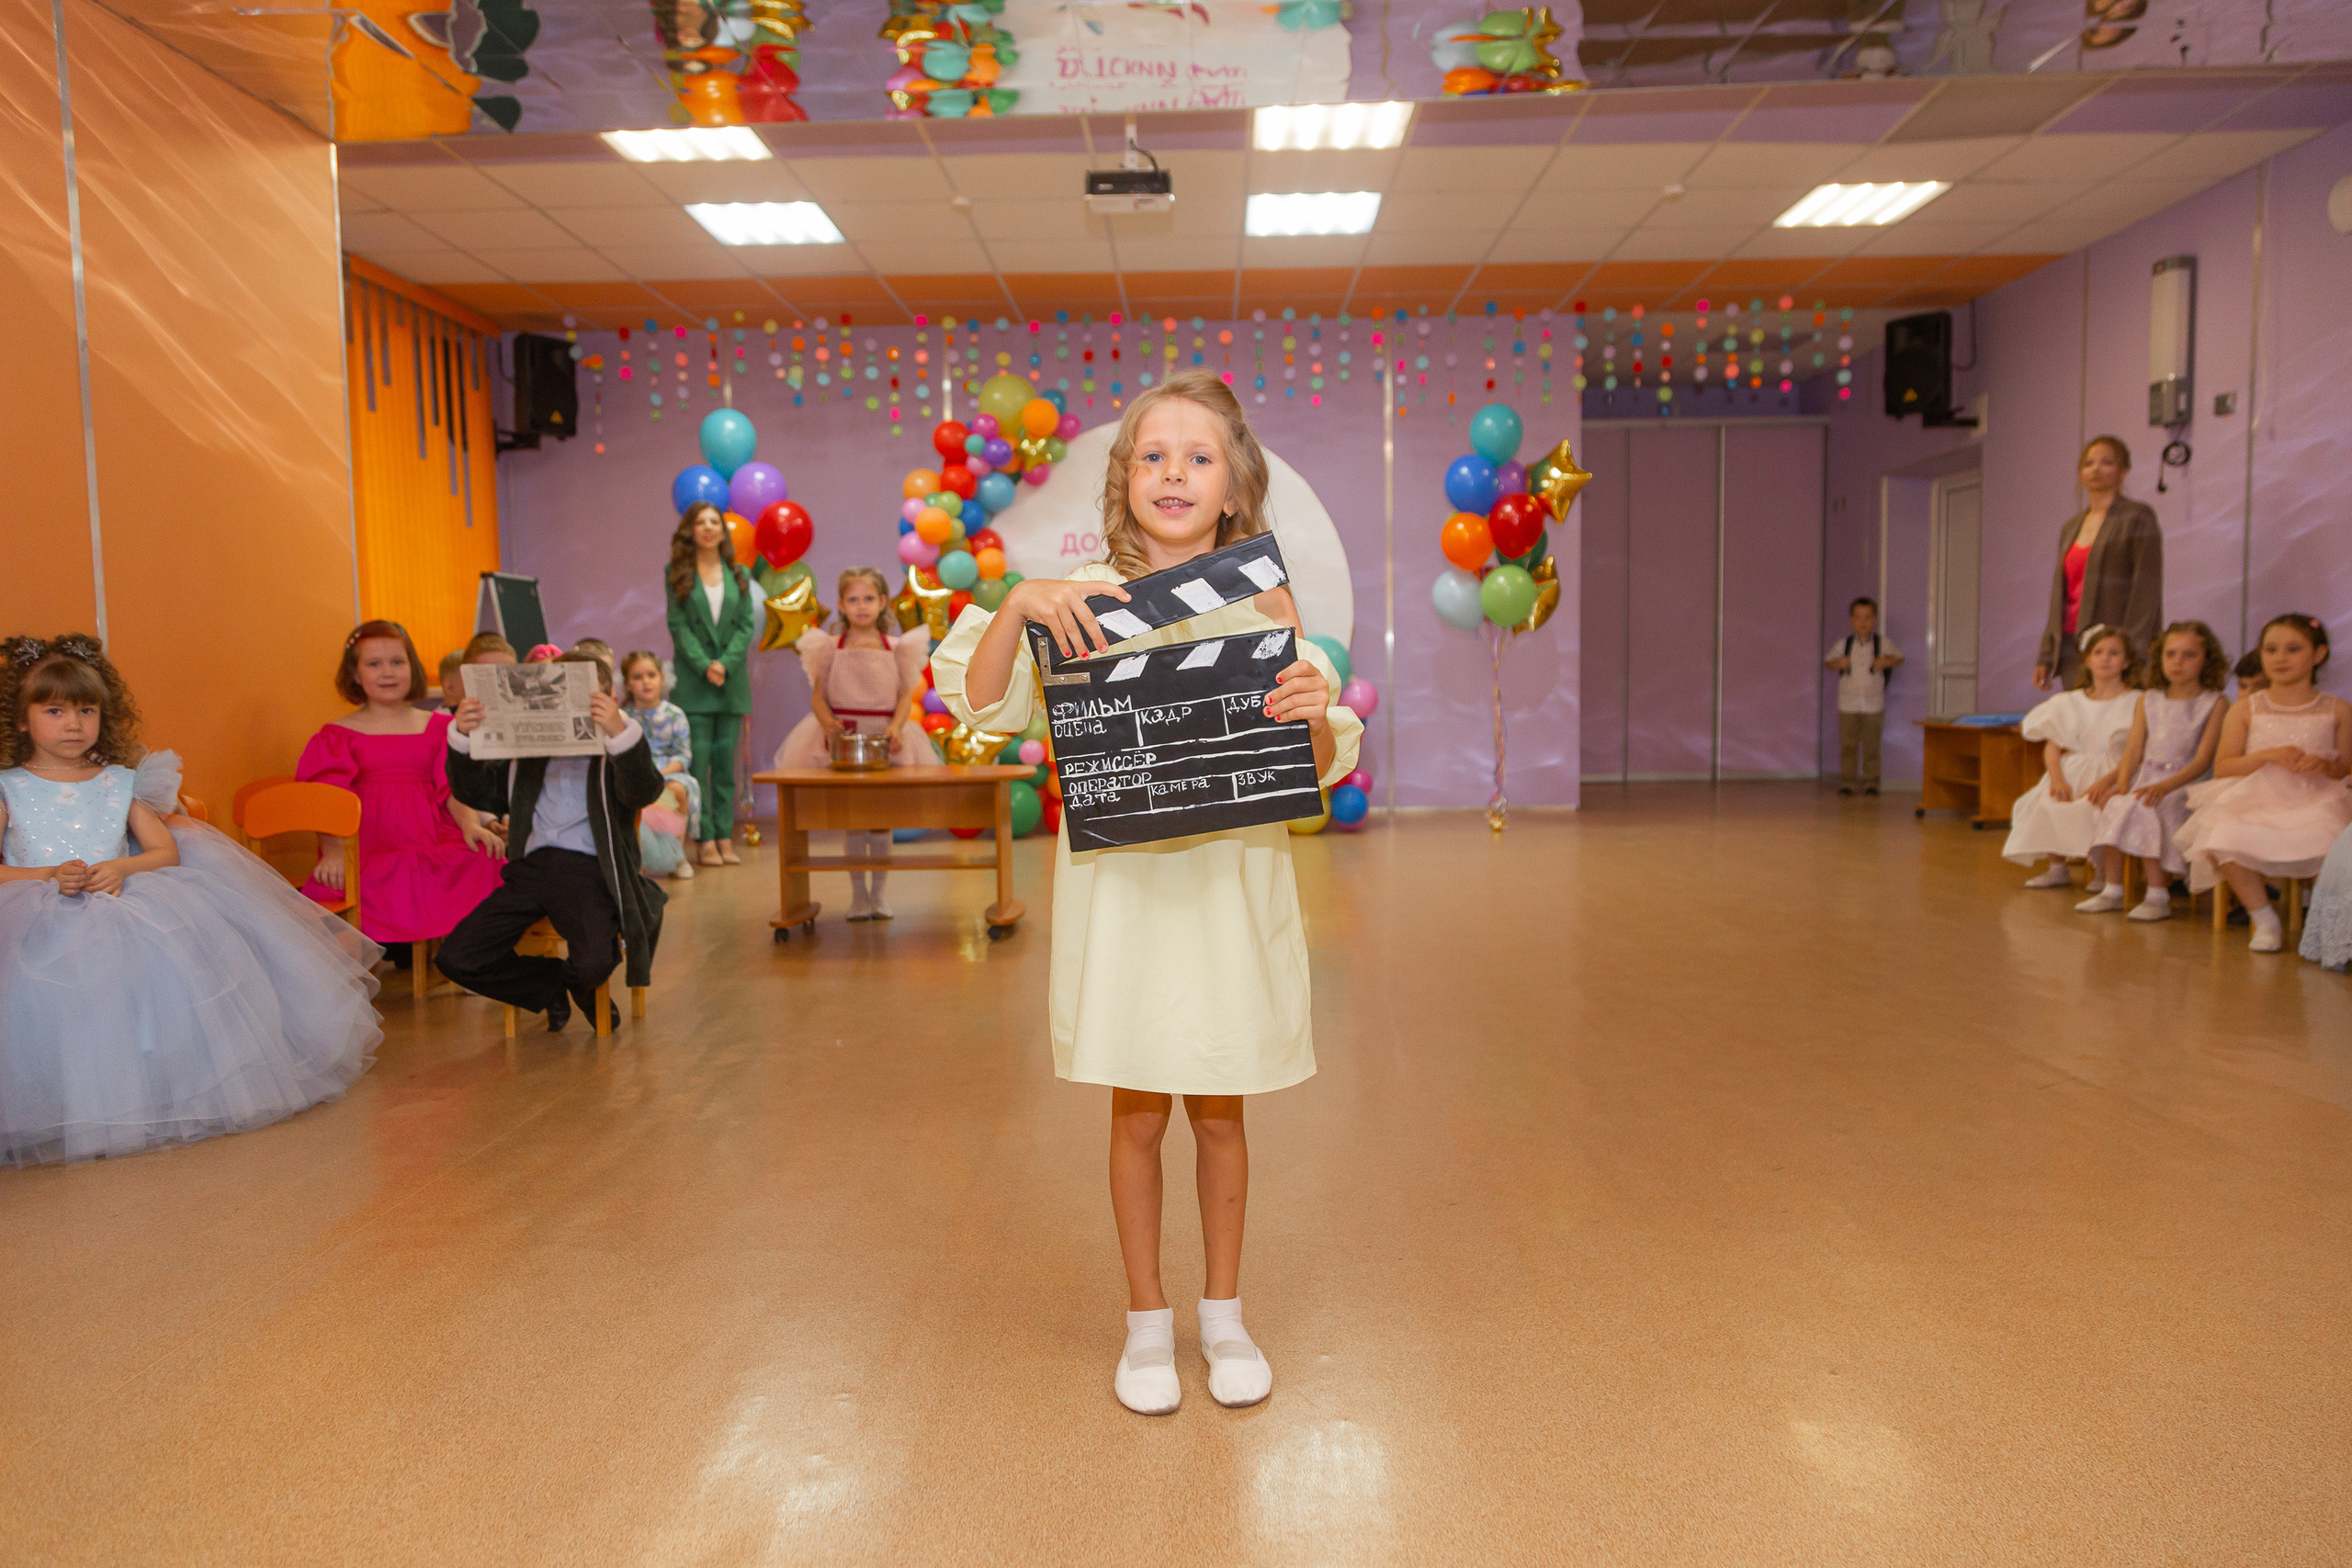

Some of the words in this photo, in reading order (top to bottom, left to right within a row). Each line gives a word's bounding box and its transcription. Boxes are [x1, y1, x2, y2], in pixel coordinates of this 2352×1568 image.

[1052, 694, 1133, 720] ФИЛЬМ
[1227, 694, 1266, 714] ДУБ
[1065, 750, 1157, 775] РЕЖИССЁР
[1238, 771, 1276, 785] ЗВУК
